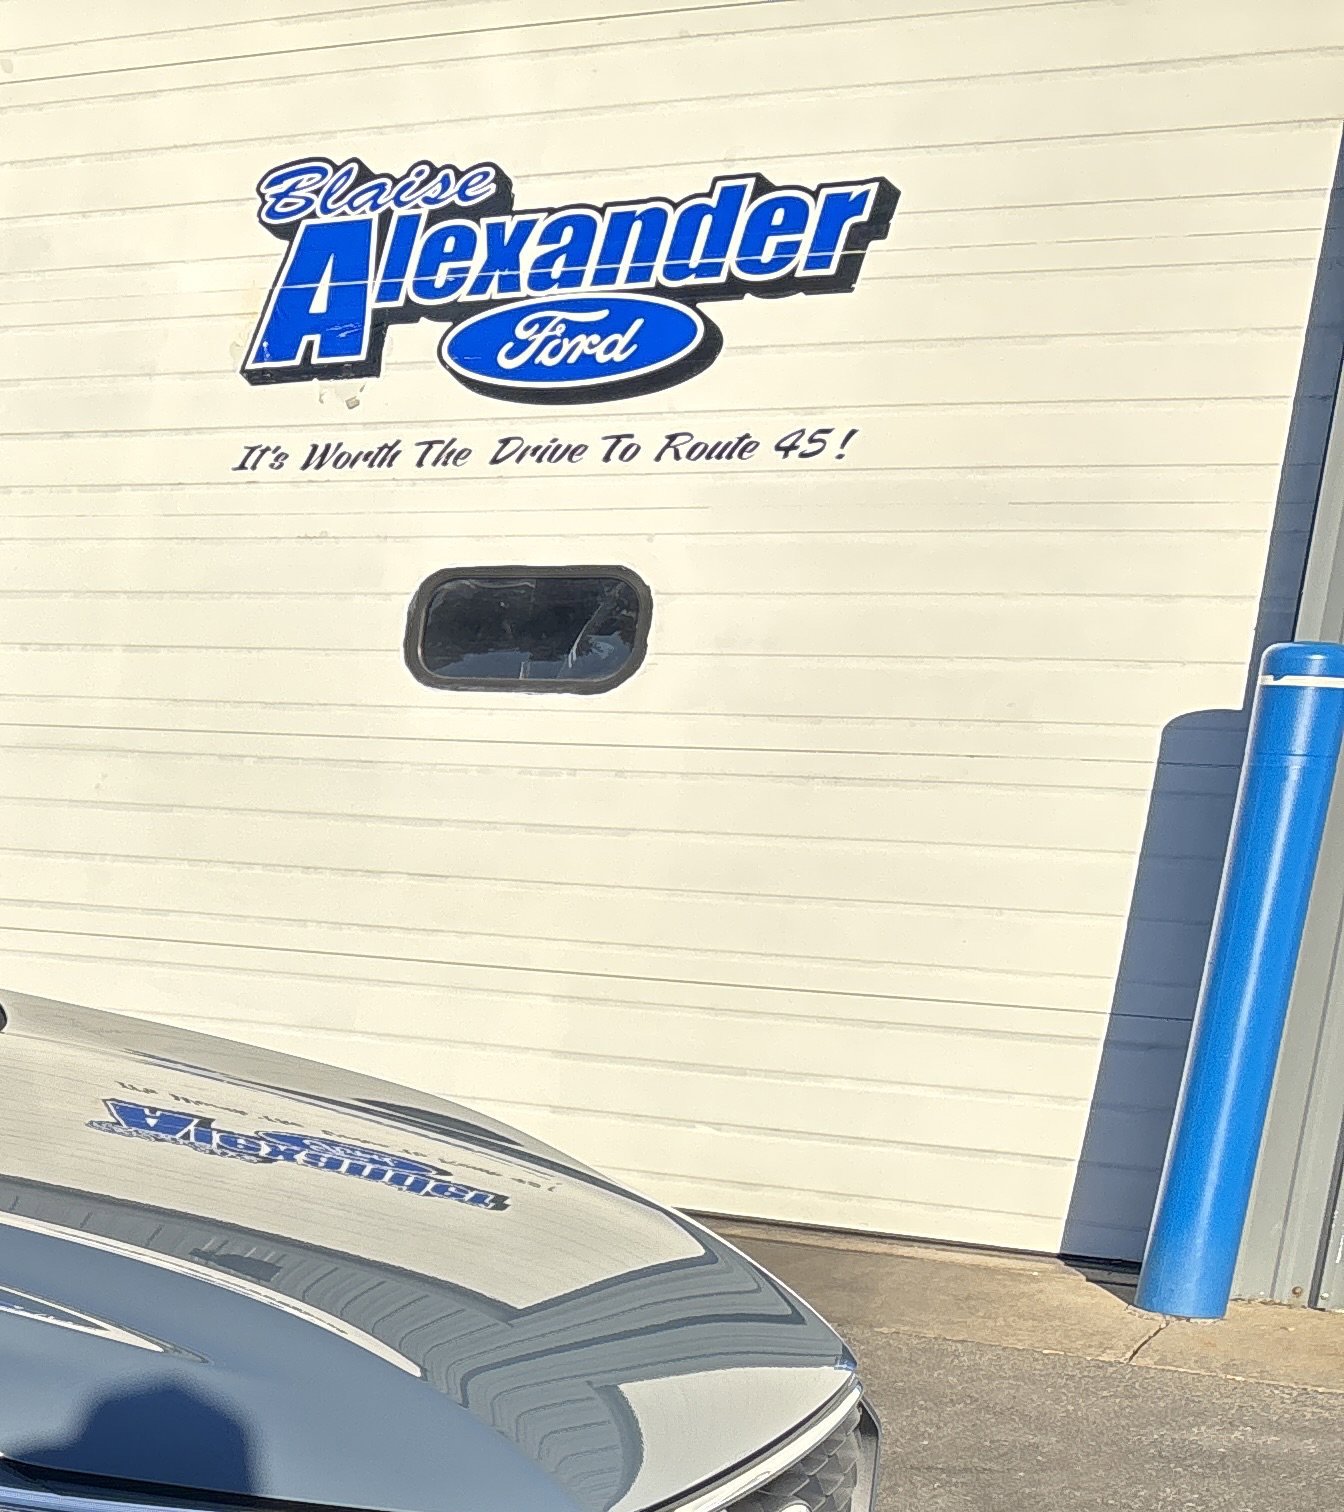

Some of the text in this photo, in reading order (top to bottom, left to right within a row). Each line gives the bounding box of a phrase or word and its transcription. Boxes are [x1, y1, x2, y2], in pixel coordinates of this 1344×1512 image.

[258, 160, 499, 224] Blaise
[243, 174, 884, 371] Alexander
[495, 307, 638, 370] Ford
[230, 427, 860, 472] It's Worth The Drive To Route 45!
